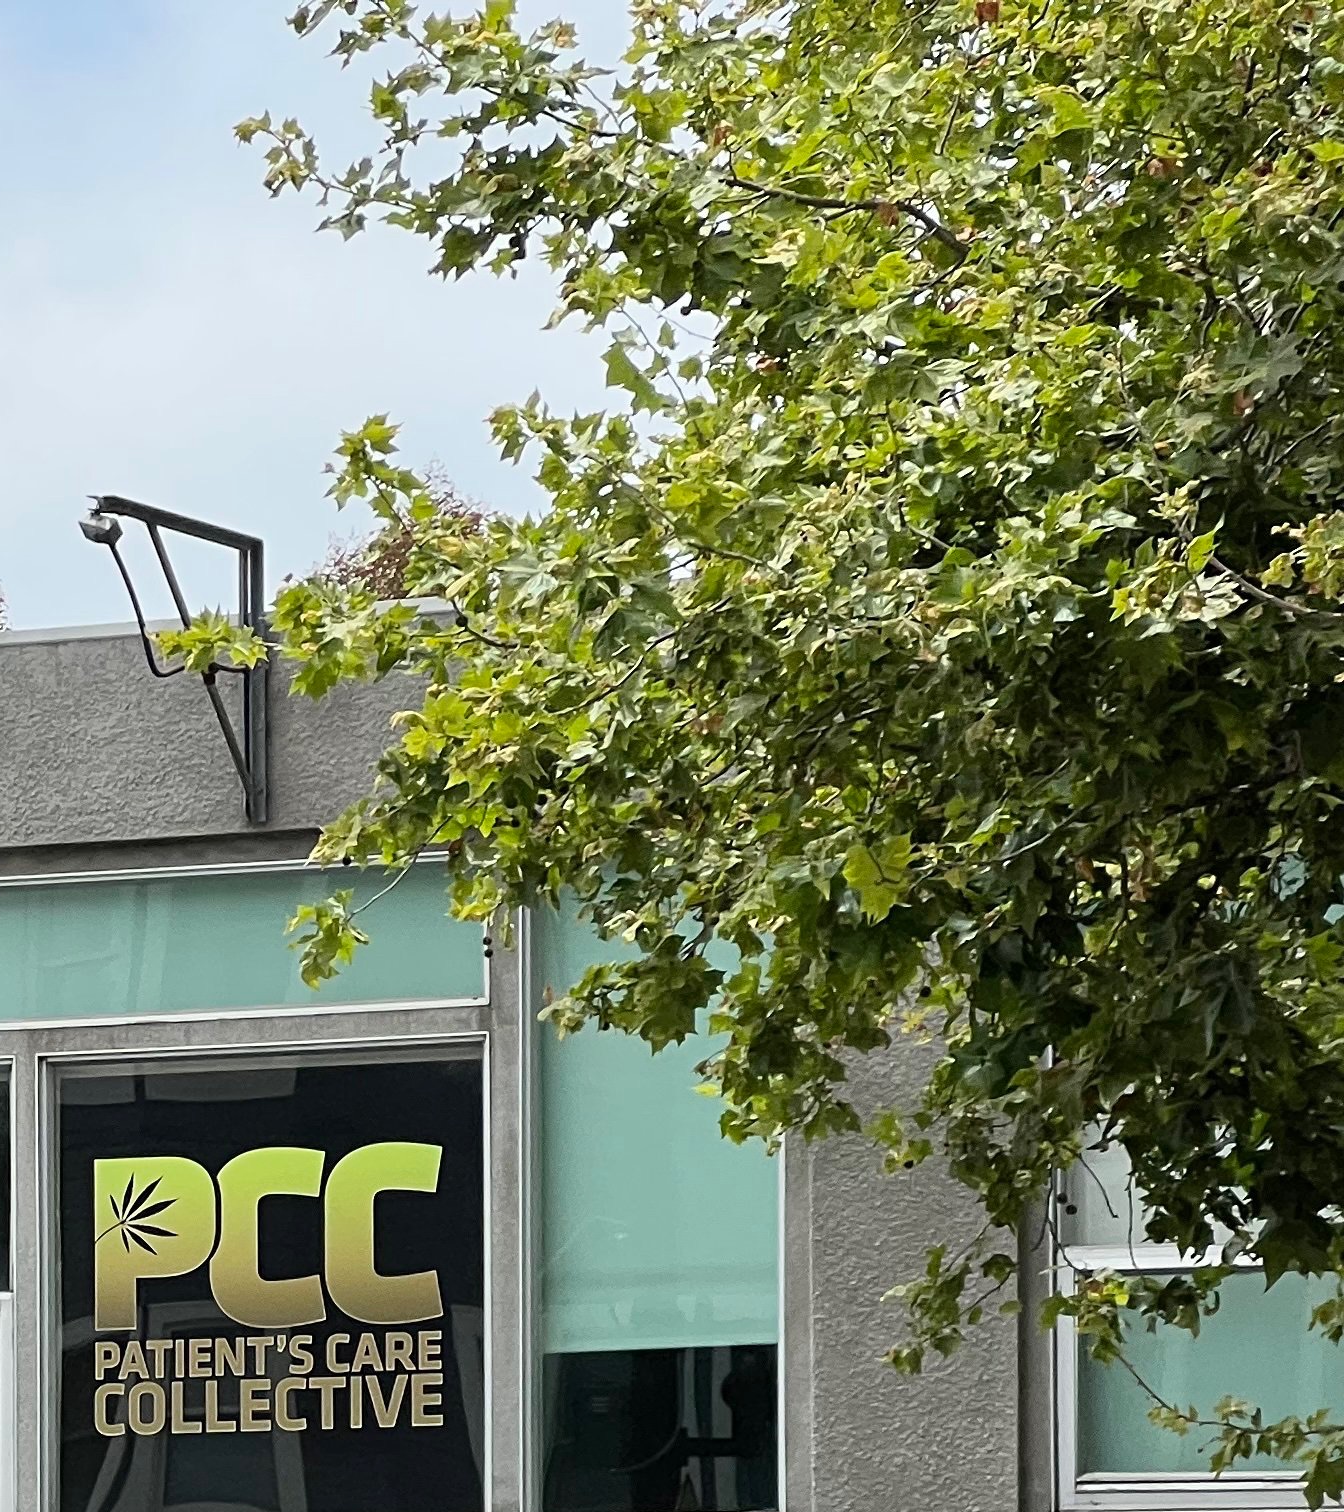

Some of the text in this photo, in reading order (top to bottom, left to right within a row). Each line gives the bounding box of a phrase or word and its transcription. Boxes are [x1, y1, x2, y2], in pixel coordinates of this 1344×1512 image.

[94, 1141, 444, 1332] PCC
[94, 1330, 444, 1381] PATIENT'S CARE
[93, 1373, 444, 1437] COLLECTIVE
